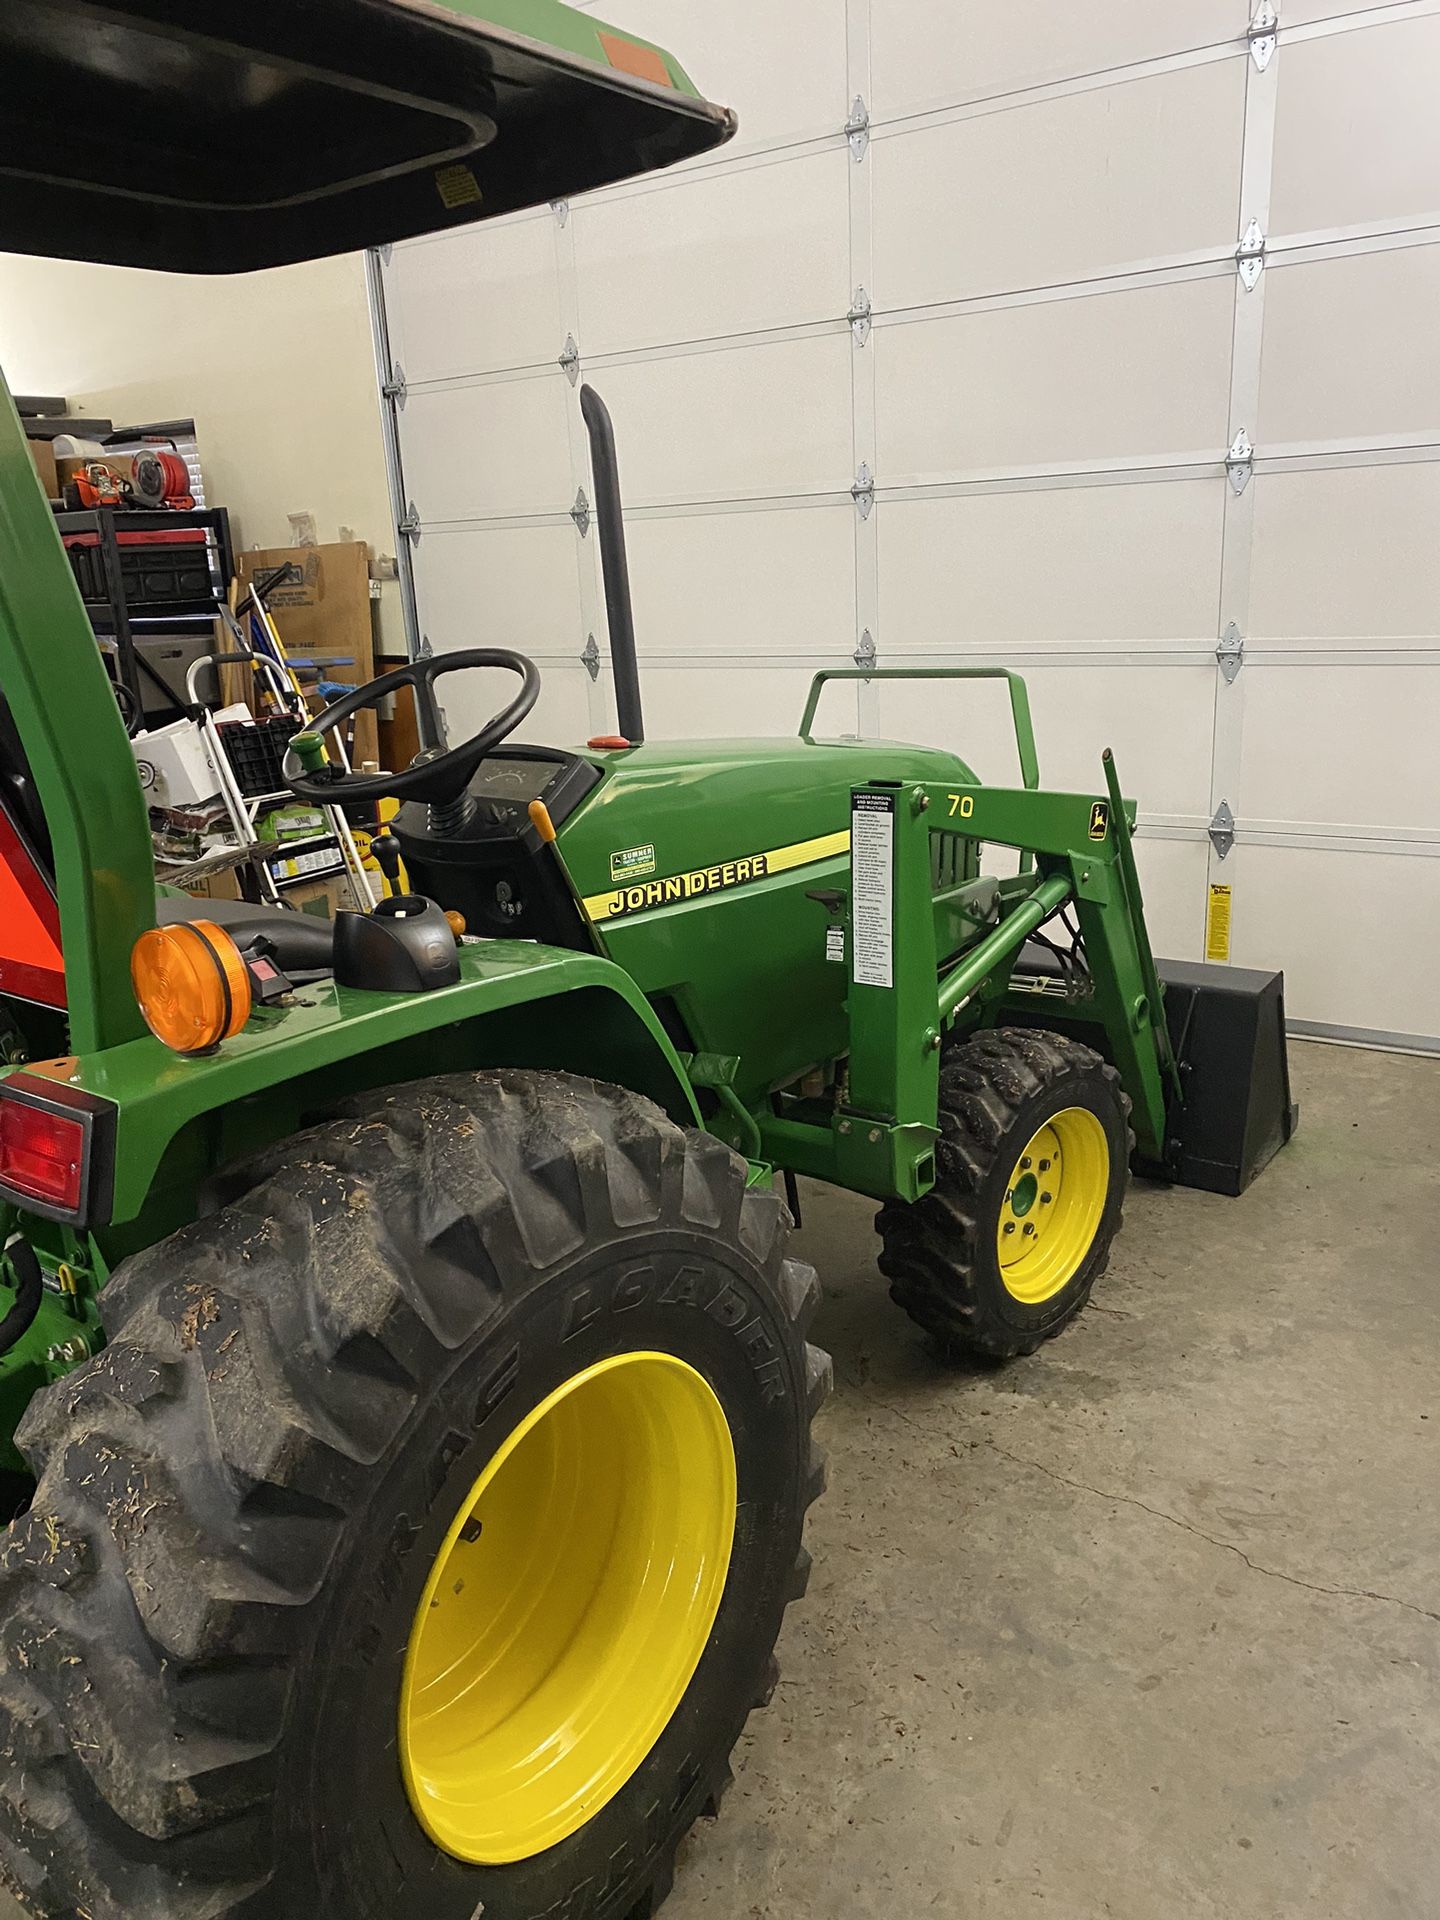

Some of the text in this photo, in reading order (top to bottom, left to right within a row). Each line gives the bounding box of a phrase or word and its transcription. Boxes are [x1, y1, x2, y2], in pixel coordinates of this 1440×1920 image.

[947, 794, 974, 817] 70
[609, 855, 766, 914] JOHN DEERE
